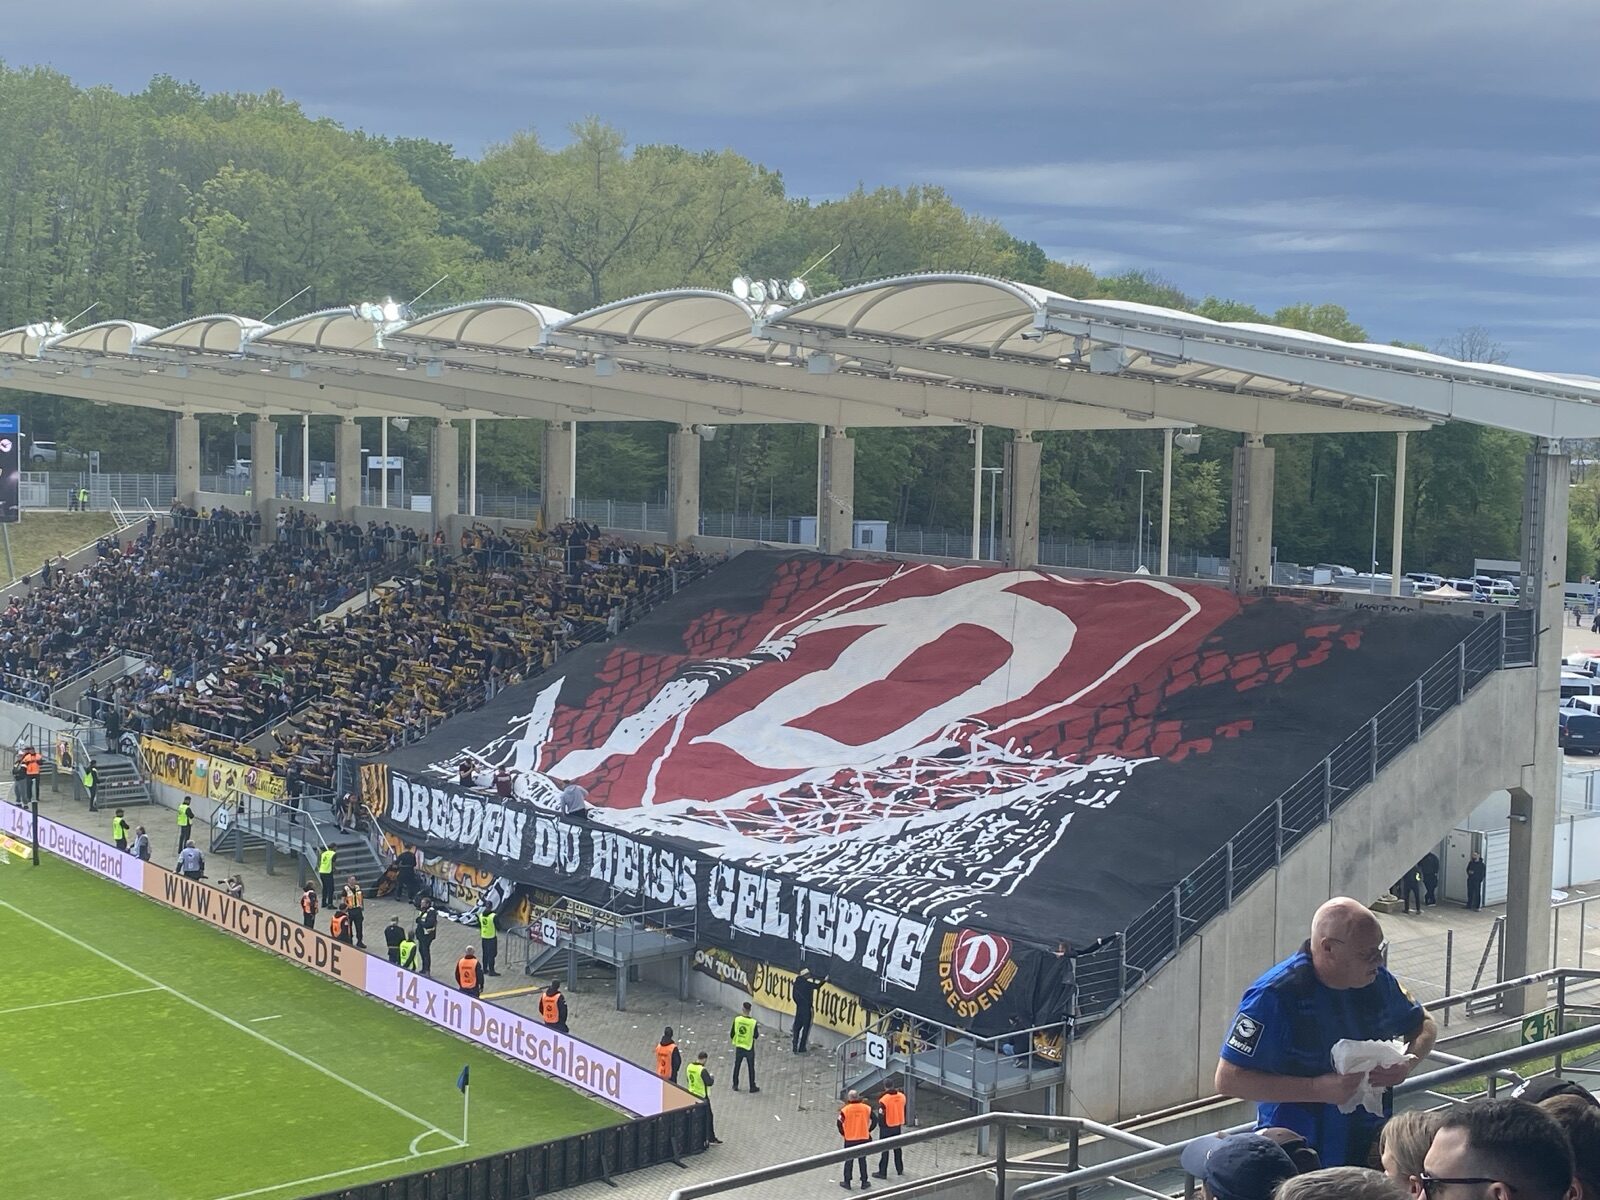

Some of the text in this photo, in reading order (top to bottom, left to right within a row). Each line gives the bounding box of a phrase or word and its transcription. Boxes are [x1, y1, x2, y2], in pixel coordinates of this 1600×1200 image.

[219, 808, 227, 825] C1
[11, 809, 24, 831] 14
[49, 824, 123, 880] Deutschland
[391, 772, 933, 991] DRESDEN DU HEISS GELIEBTE
[164, 873, 342, 976] WWW.VICTORS.DE
[543, 924, 555, 940] C2
[695, 950, 714, 969] ON
[938, 960, 1004, 1018] DRESDEN
[395, 970, 621, 1099] 14 x in Deutschland
[868, 1040, 885, 1060] C3
[1228, 1036, 1252, 1053] bwin
